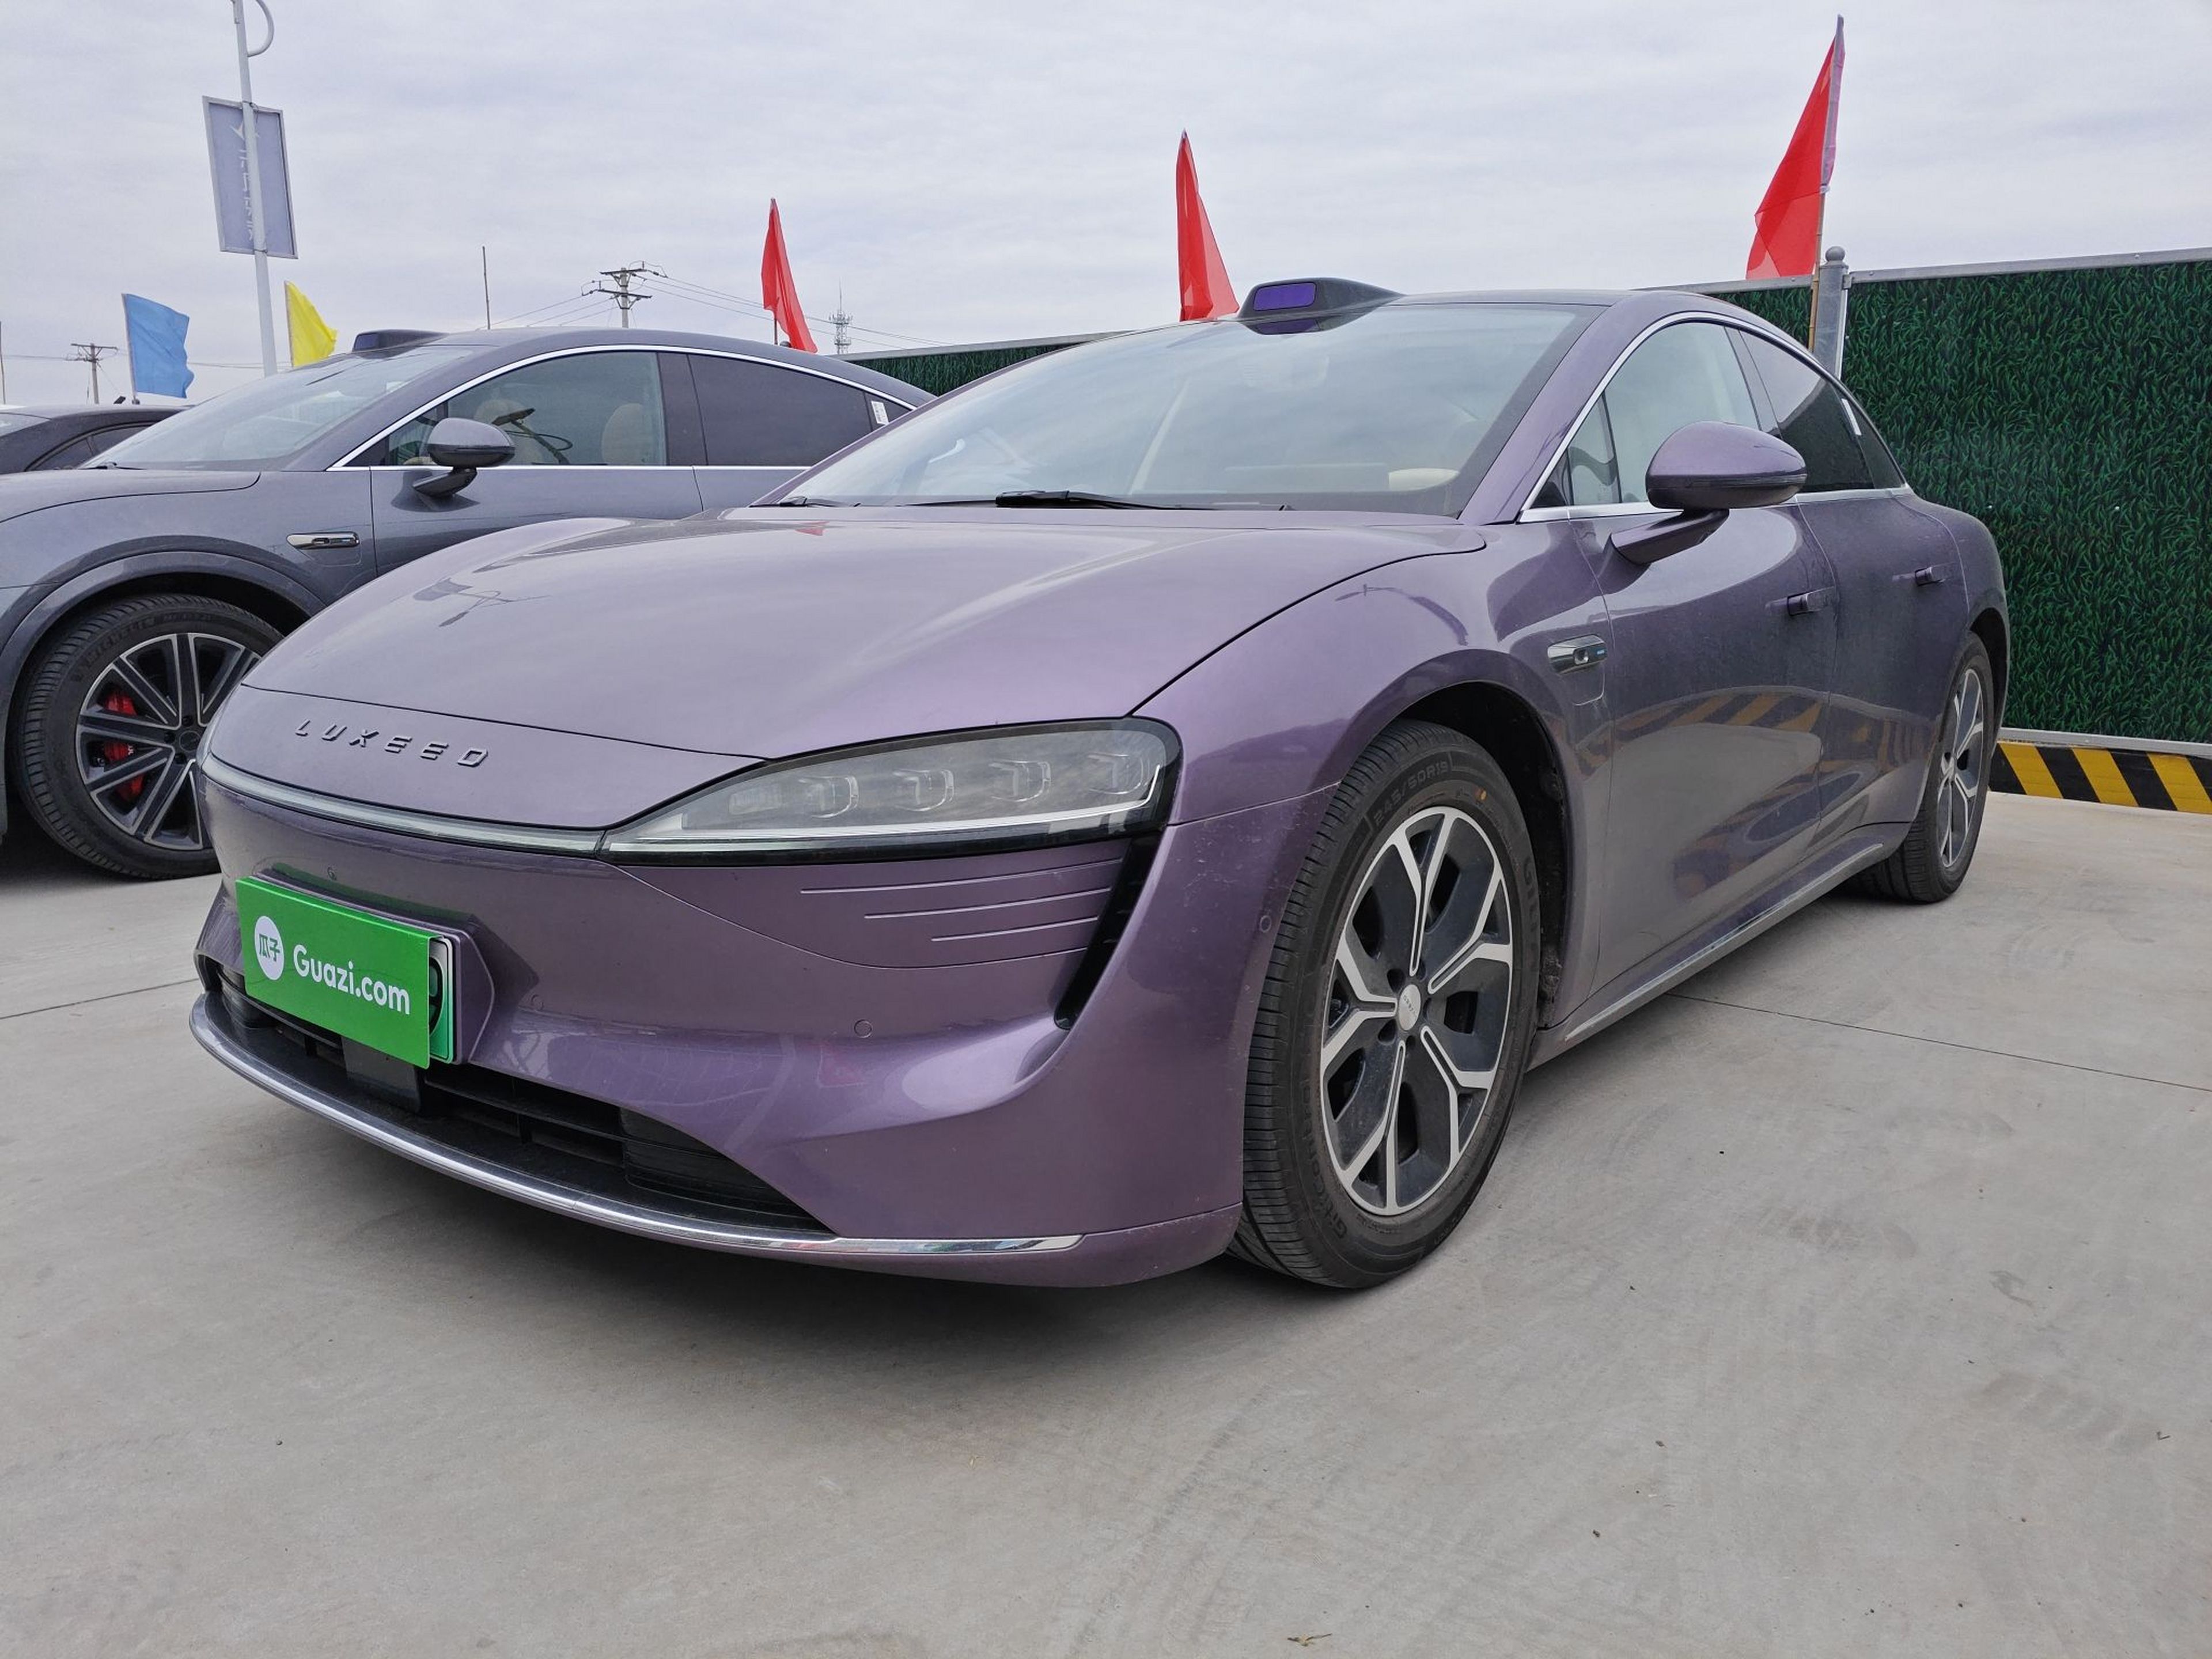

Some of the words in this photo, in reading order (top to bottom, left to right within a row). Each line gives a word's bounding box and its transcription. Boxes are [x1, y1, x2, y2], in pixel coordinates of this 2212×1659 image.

[295, 718, 489, 768] LUXEED
[257, 933, 281, 963] 瓜子
[293, 944, 411, 1016] Guazi.com
